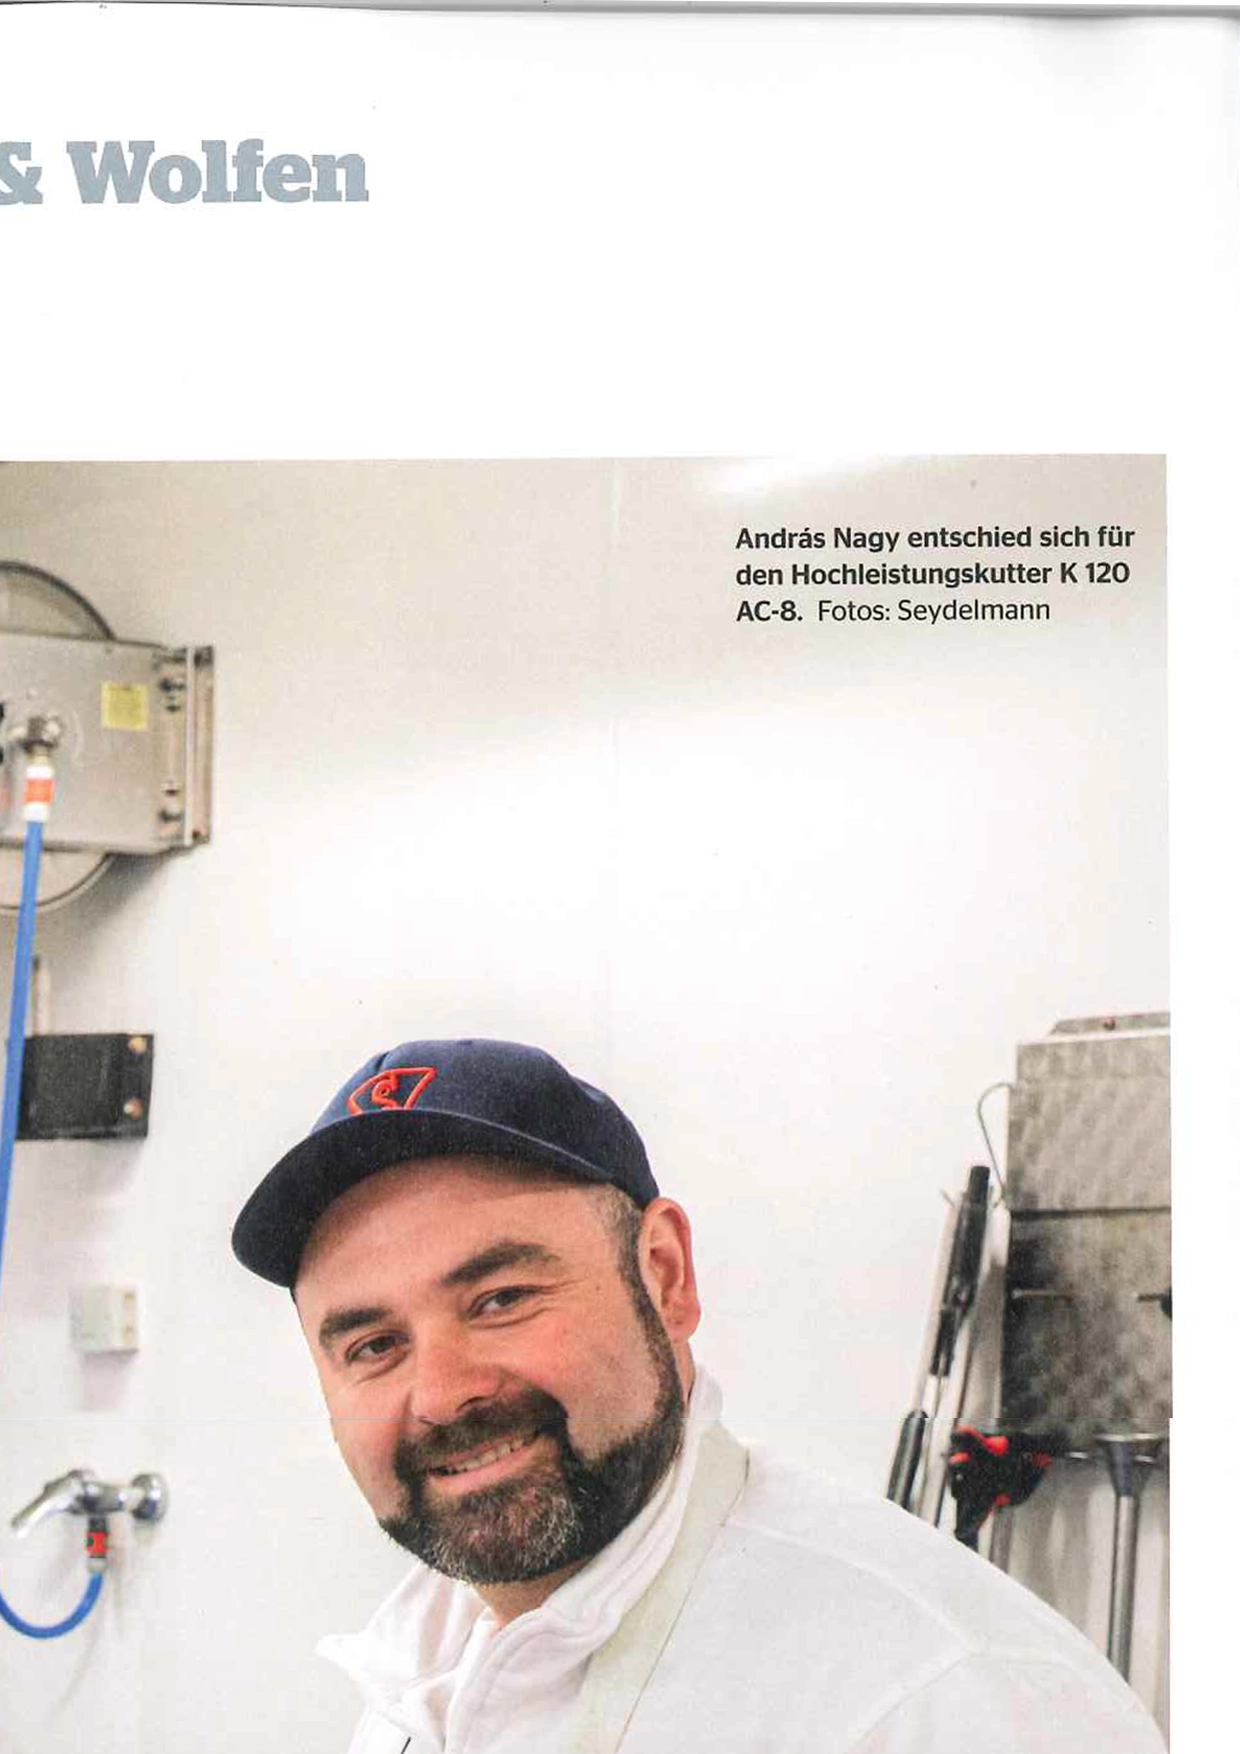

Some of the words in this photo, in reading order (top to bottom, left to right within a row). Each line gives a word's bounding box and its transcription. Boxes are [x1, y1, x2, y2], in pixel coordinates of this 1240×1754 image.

[66, 138, 370, 205] Wolfen
[735, 525, 826, 549] András
[834, 527, 900, 553] Nagy
[907, 525, 1032, 548] entschied
[1039, 525, 1090, 548] sich
[1097, 525, 1136, 548] für
[736, 563, 783, 586] den
[791, 562, 1053, 589] Hochleistungskutter
[1060, 562, 1078, 584] K
[1085, 561, 1131, 584] 120
[736, 600, 803, 622] AC-8.
[818, 599, 890, 622] Fotos:
[897, 598, 1050, 625] Seydelmann
